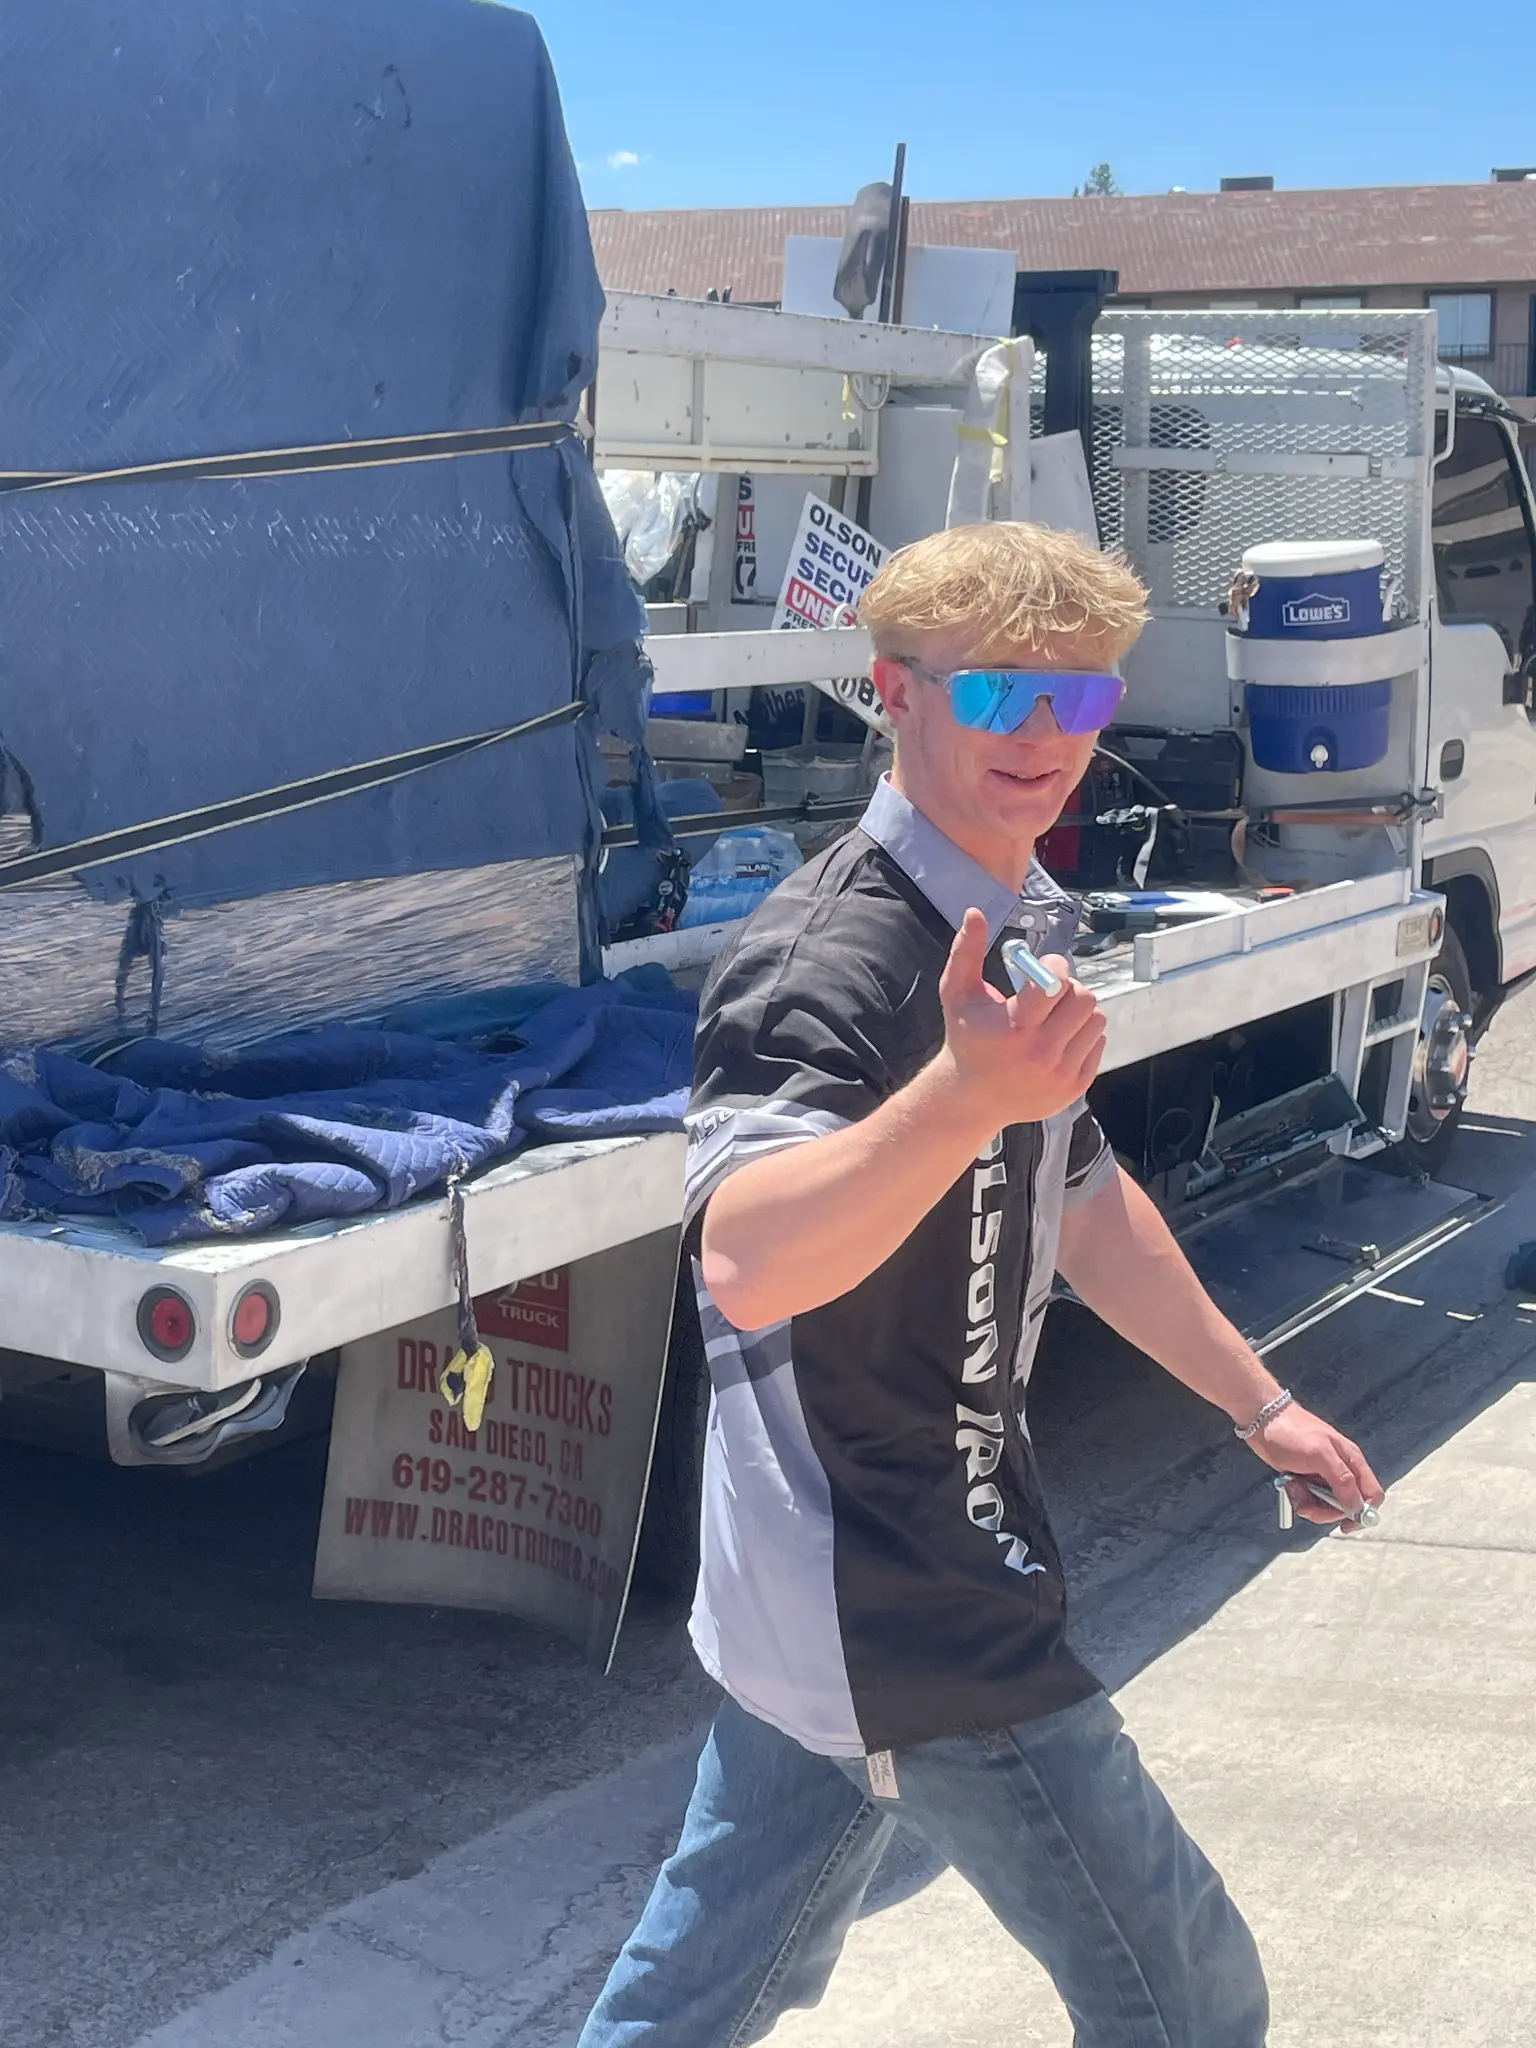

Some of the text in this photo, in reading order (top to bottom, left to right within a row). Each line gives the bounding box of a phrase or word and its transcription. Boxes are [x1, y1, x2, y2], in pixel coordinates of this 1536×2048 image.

[809, 504, 882, 569] OLSON
[1289, 604, 1343, 621] LOWE'S
[499, 1304, 559, 1329] TRUCK
[507, 1358, 613, 1437] TRUCKS
[560, 1440, 583, 1482] CA
[955, 1402, 1047, 1576] IRON
[392, 1453, 603, 1538] 619-287-7300
